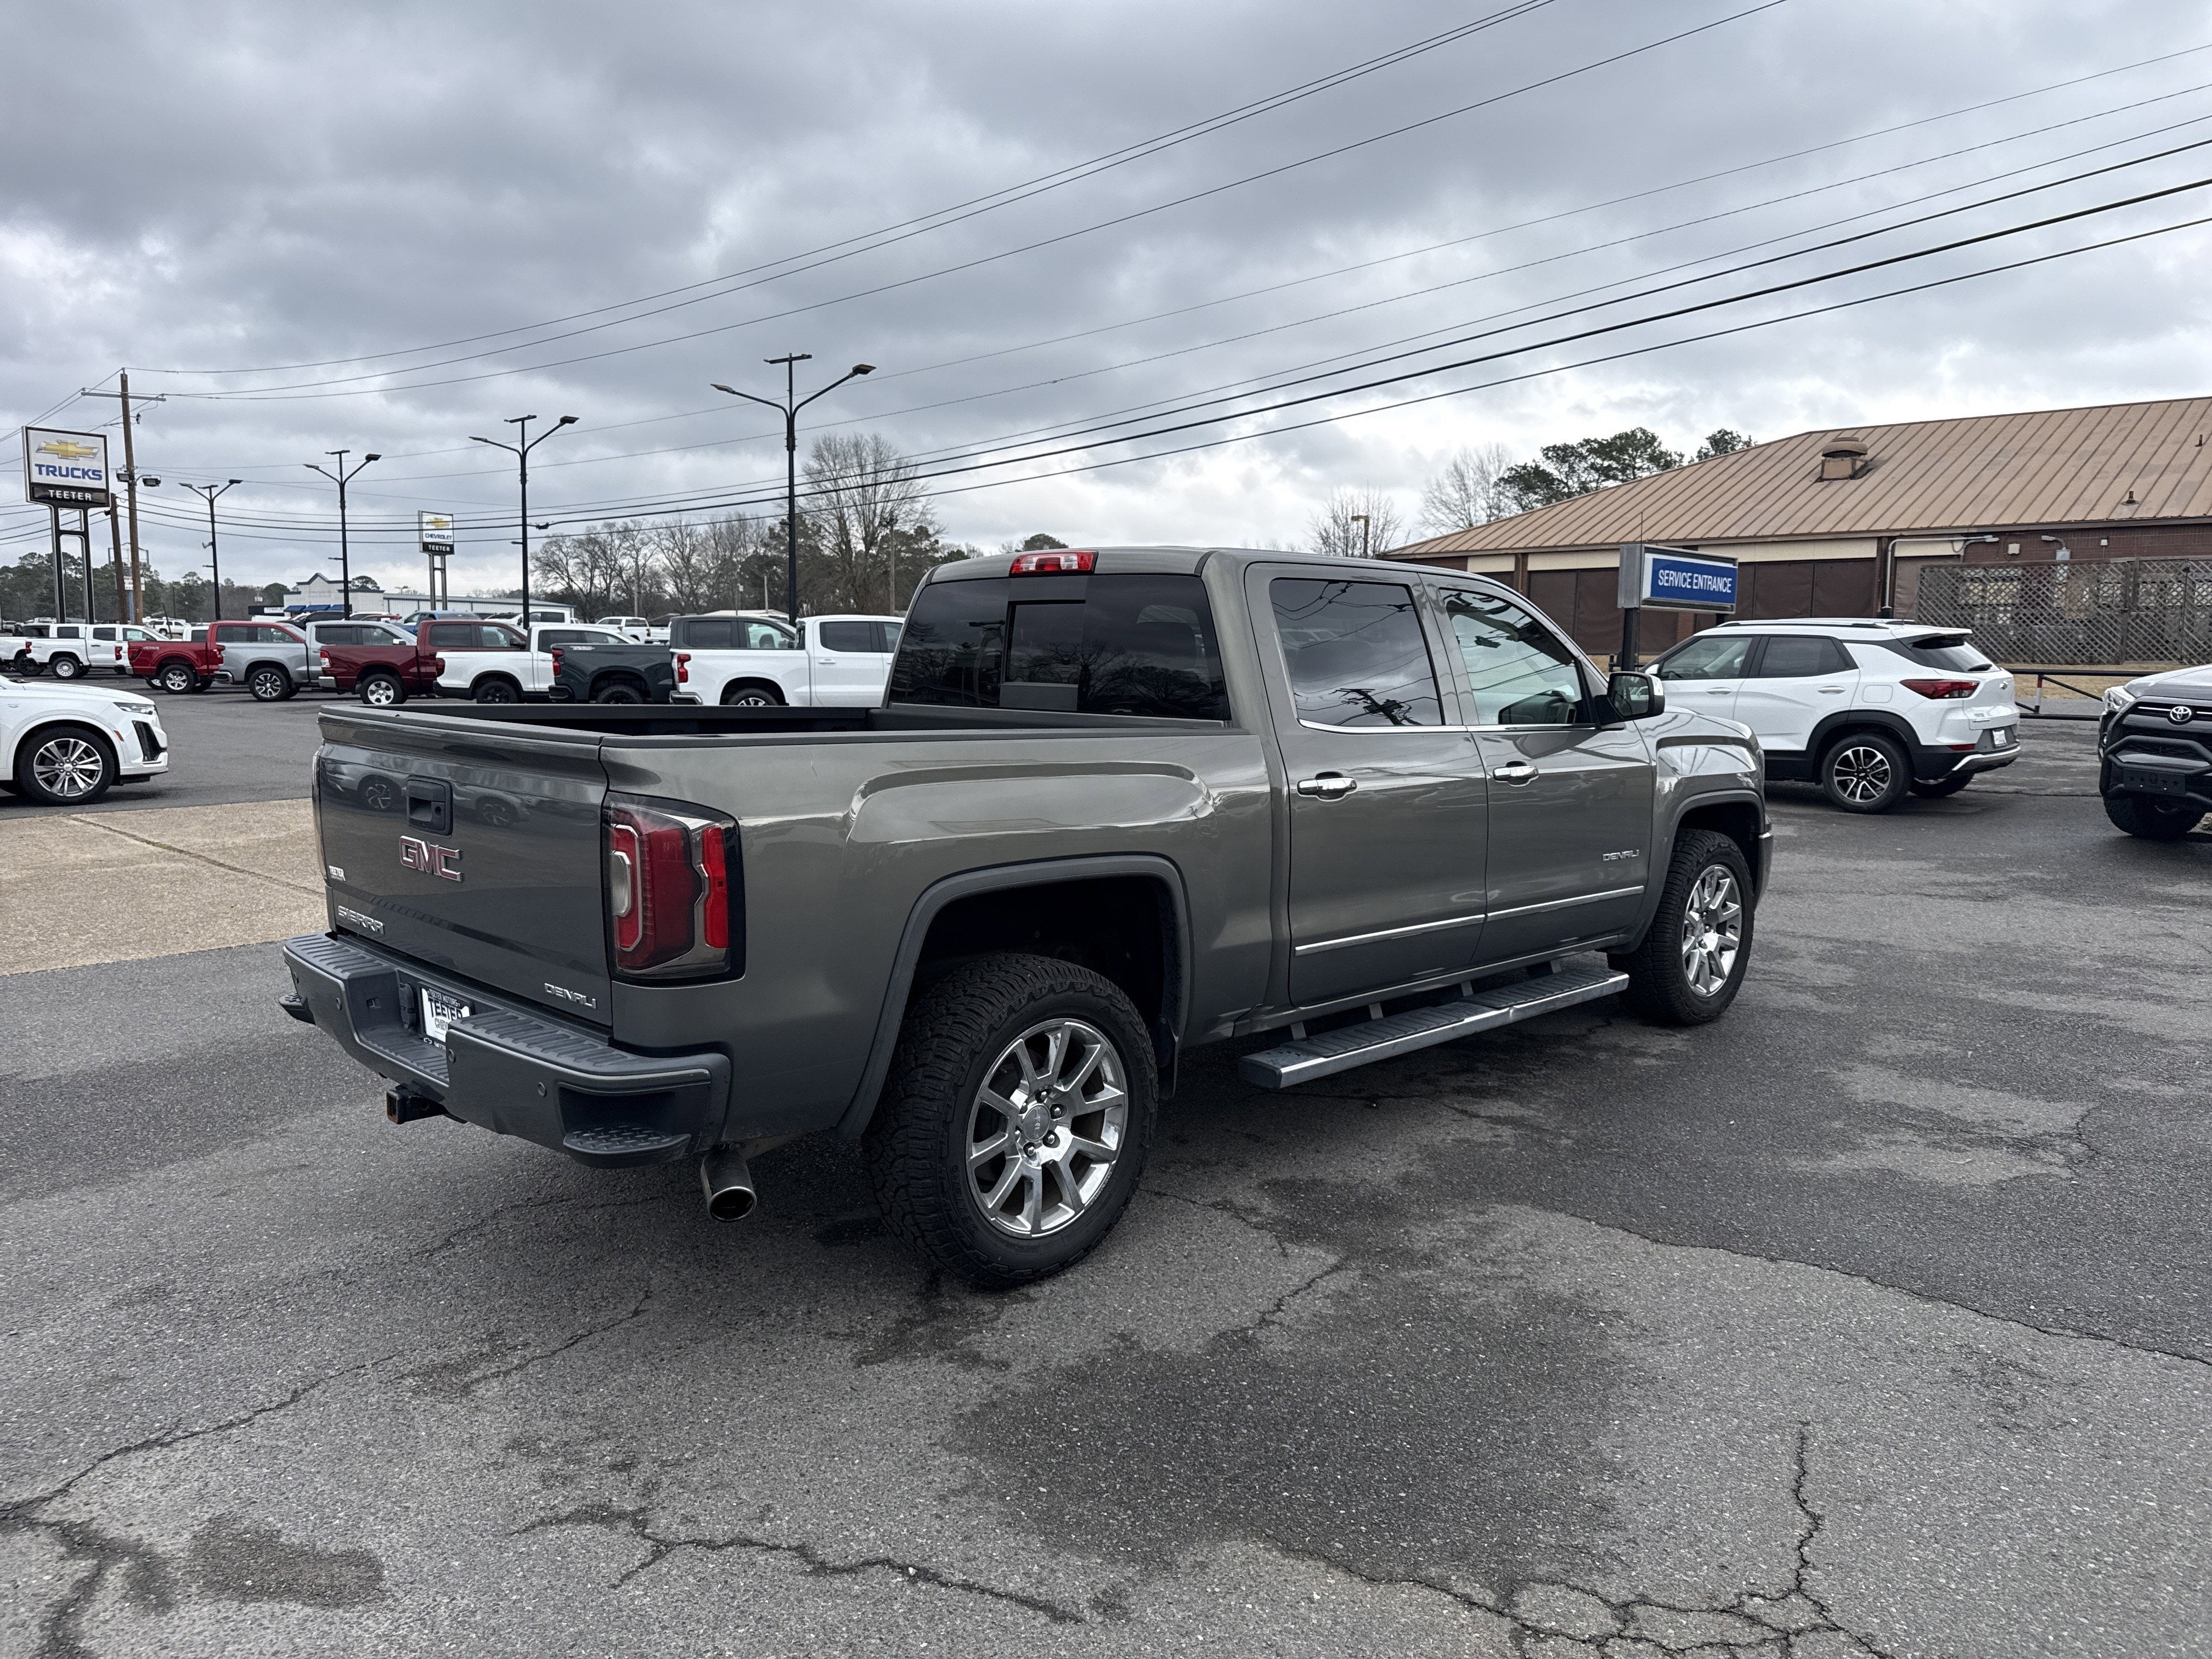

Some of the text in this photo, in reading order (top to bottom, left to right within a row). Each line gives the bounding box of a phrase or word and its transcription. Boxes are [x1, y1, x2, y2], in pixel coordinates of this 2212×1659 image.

[35, 464, 103, 481] TRUCKS
[48, 489, 92, 501] TEETER
[1658, 569, 1733, 593] SERVICE ENTRANCE
[399, 835, 461, 882] GMC
[1602, 849, 1640, 861] DENALI
[329, 865, 346, 882] TEETER
[338, 905, 385, 935] SIERRA
[544, 983, 597, 1009] DENALI
